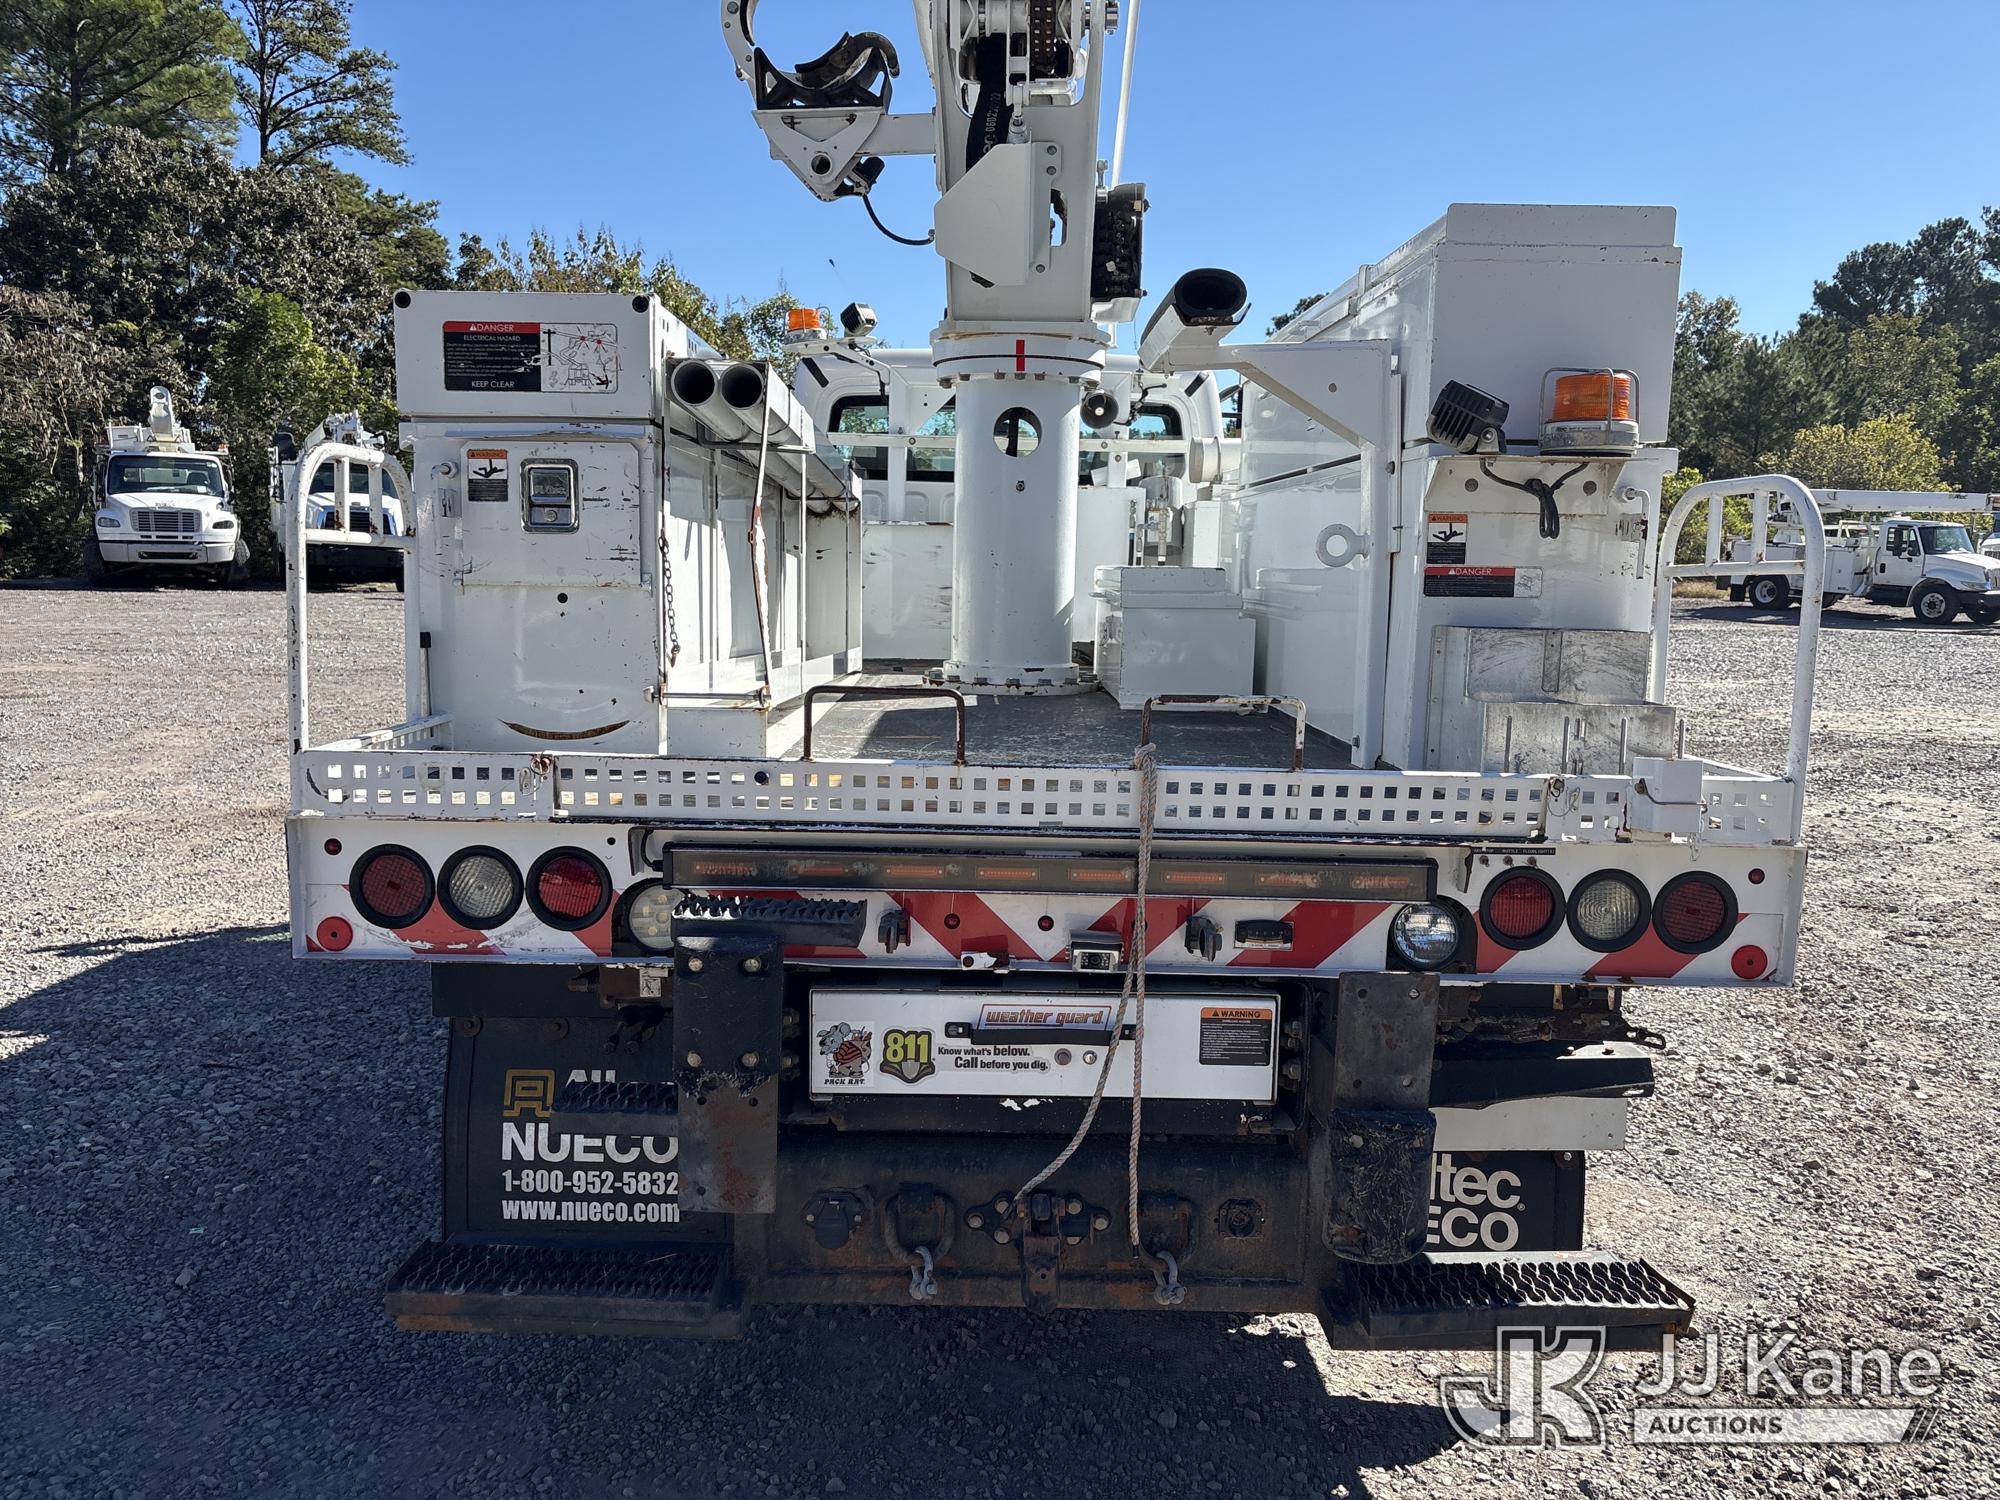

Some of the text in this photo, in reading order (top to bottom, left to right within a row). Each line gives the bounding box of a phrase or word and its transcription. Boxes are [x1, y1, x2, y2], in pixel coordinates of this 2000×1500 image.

[476, 324, 514, 332] DANGER
[471, 380, 489, 388] KEEP
[985, 1009, 1053, 1023] weather
[886, 1032, 929, 1063] 811
[938, 1046, 1030, 1056] Know what's below.
[954, 1056, 1049, 1071] Call before you dig.
[501, 1122, 679, 1164] NUECO
[501, 1169, 679, 1195] 1-800-952-5832
[501, 1199, 680, 1223] www.nueco.com
